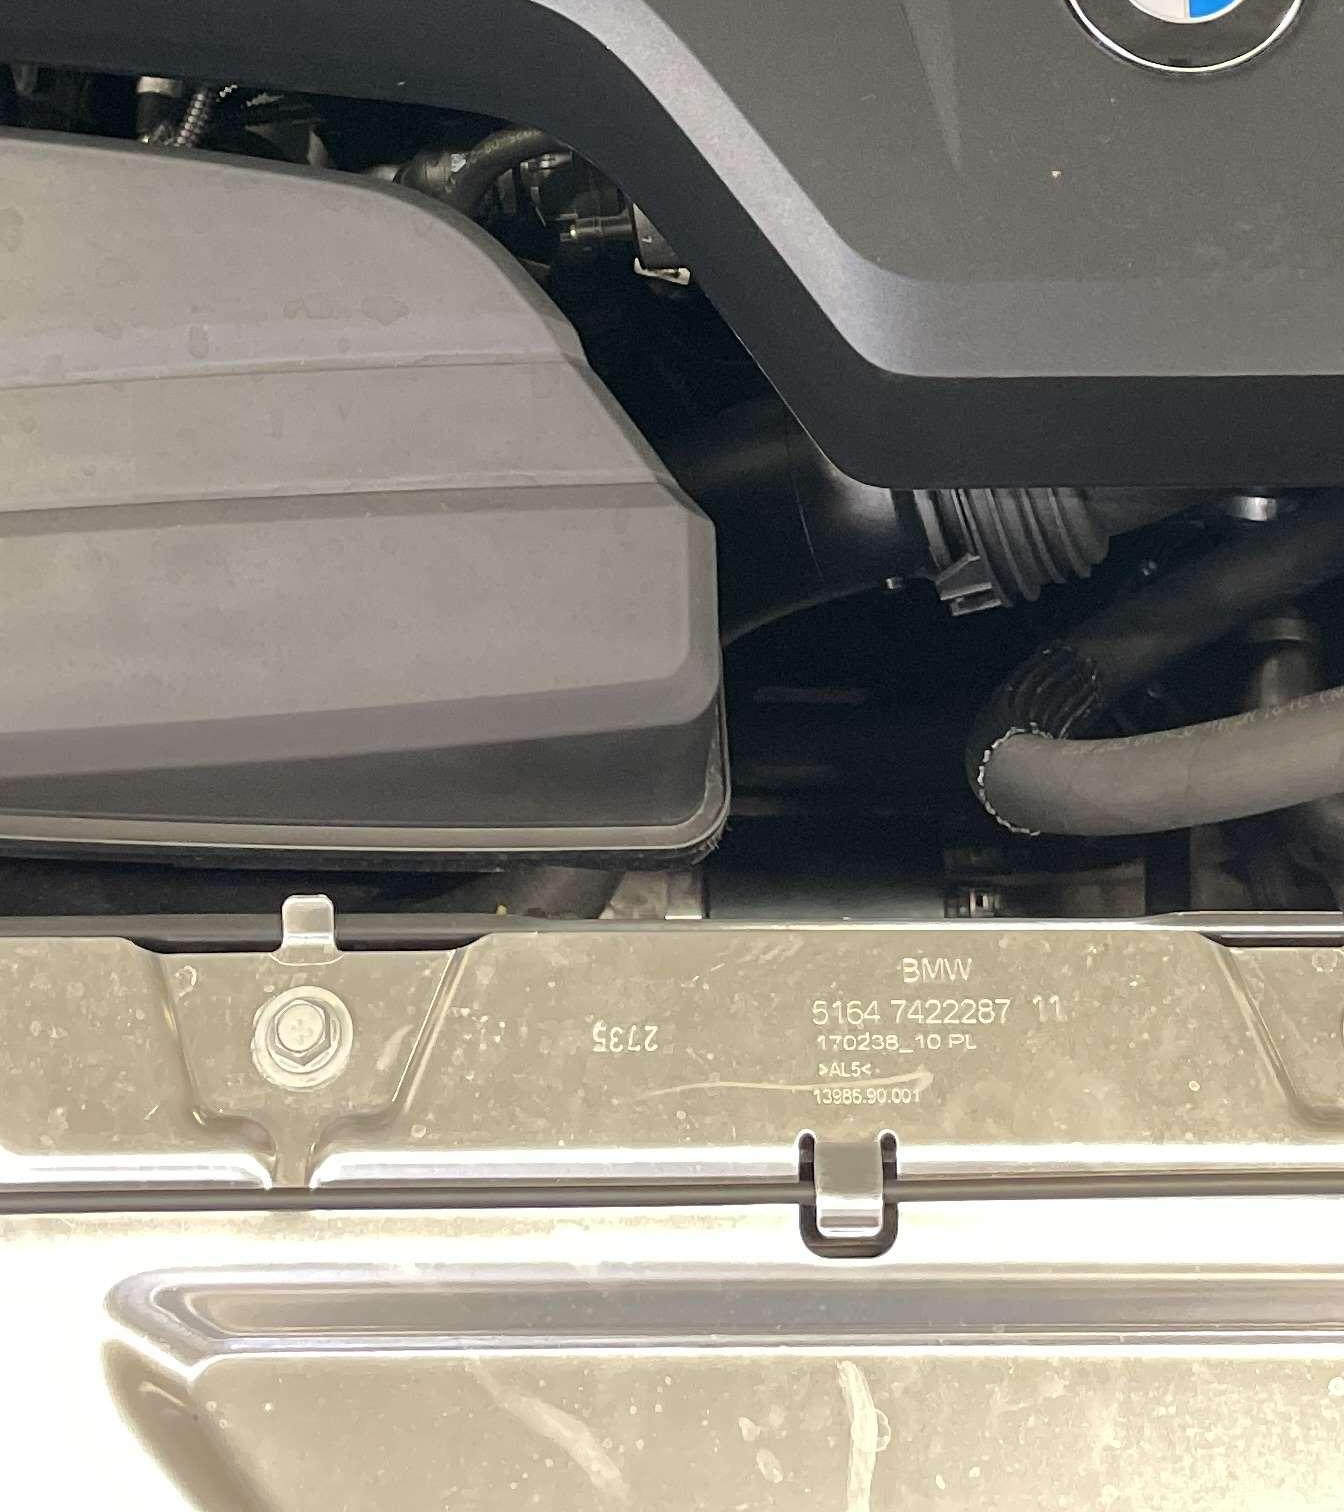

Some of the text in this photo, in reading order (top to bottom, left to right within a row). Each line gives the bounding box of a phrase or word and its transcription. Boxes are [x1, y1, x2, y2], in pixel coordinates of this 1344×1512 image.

[902, 957, 973, 984] BMW
[811, 999, 881, 1026] 5164
[889, 998, 1012, 1025] 7422287
[592, 1021, 659, 1052] 2735
[948, 1033, 977, 1051] PL
